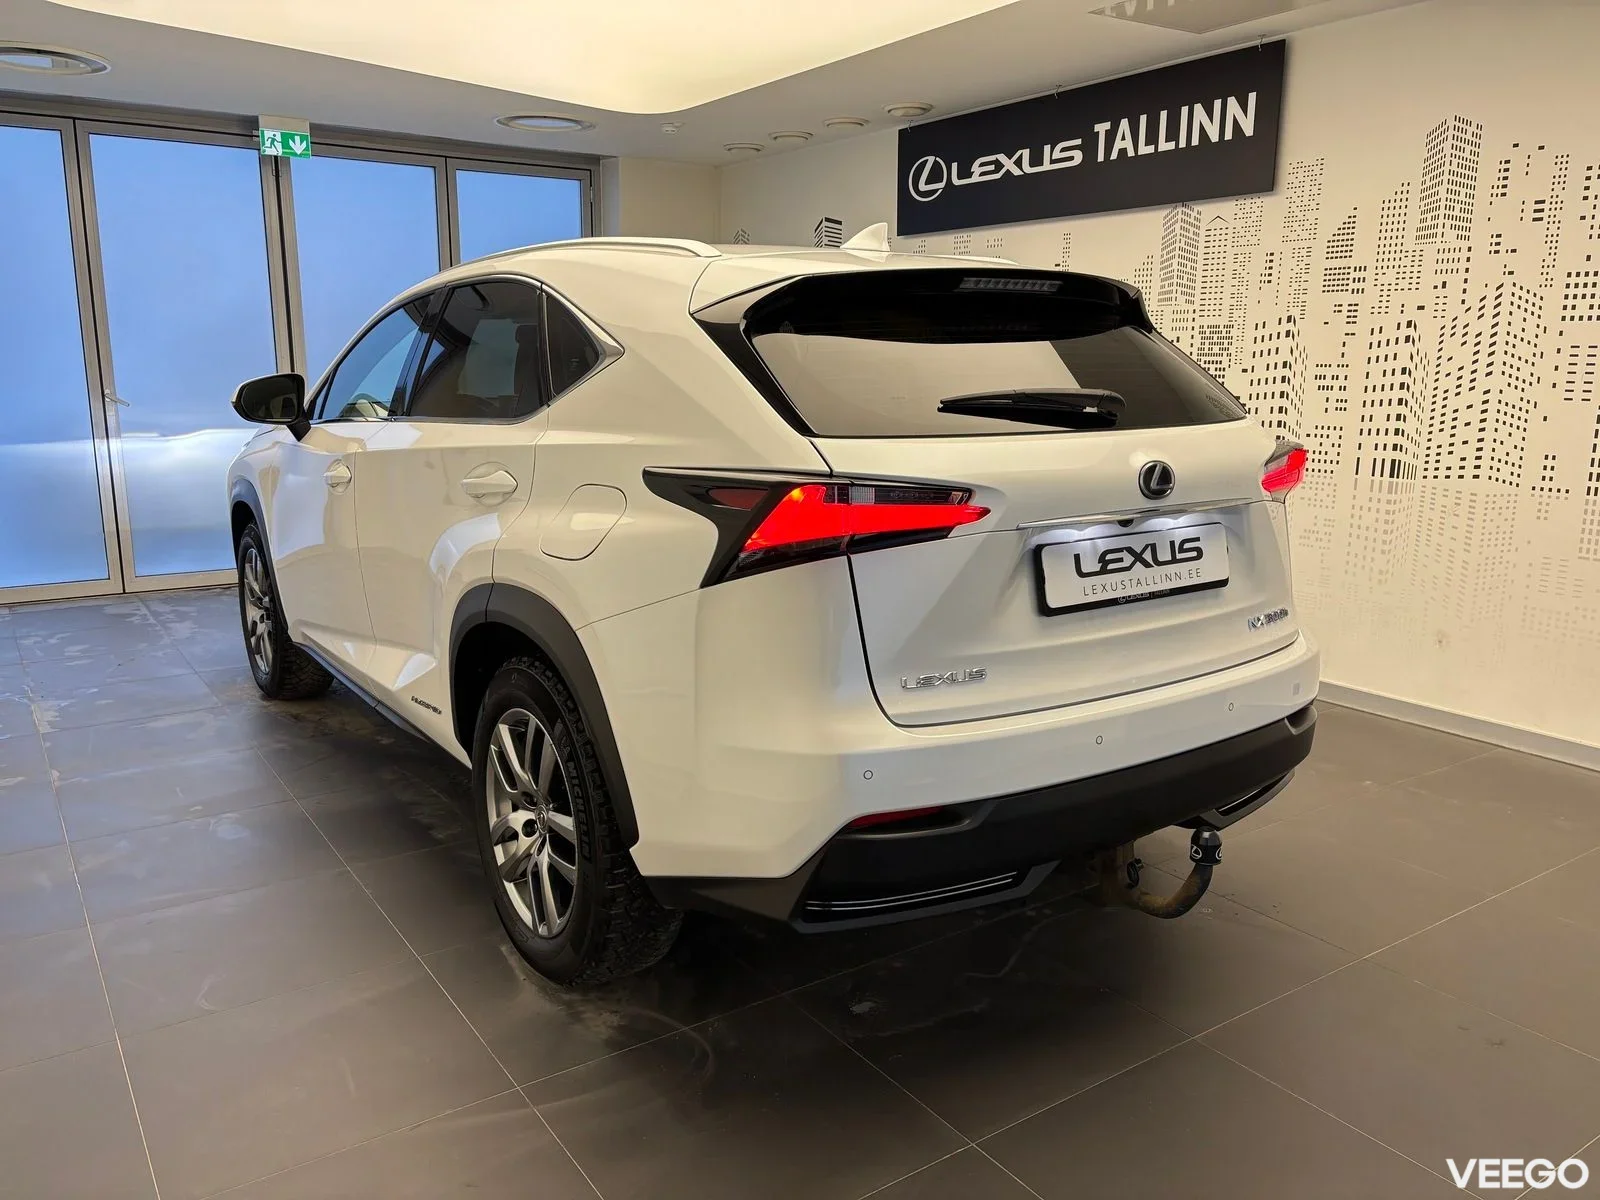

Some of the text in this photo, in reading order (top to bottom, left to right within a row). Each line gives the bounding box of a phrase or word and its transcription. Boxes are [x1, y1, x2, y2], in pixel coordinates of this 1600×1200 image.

[951, 91, 1257, 186] LEXUS TALLINN
[1073, 536, 1204, 579] LEXUS
[1083, 567, 1202, 597] LEXUSTALLINN.EE
[901, 667, 987, 690] LEXUS
